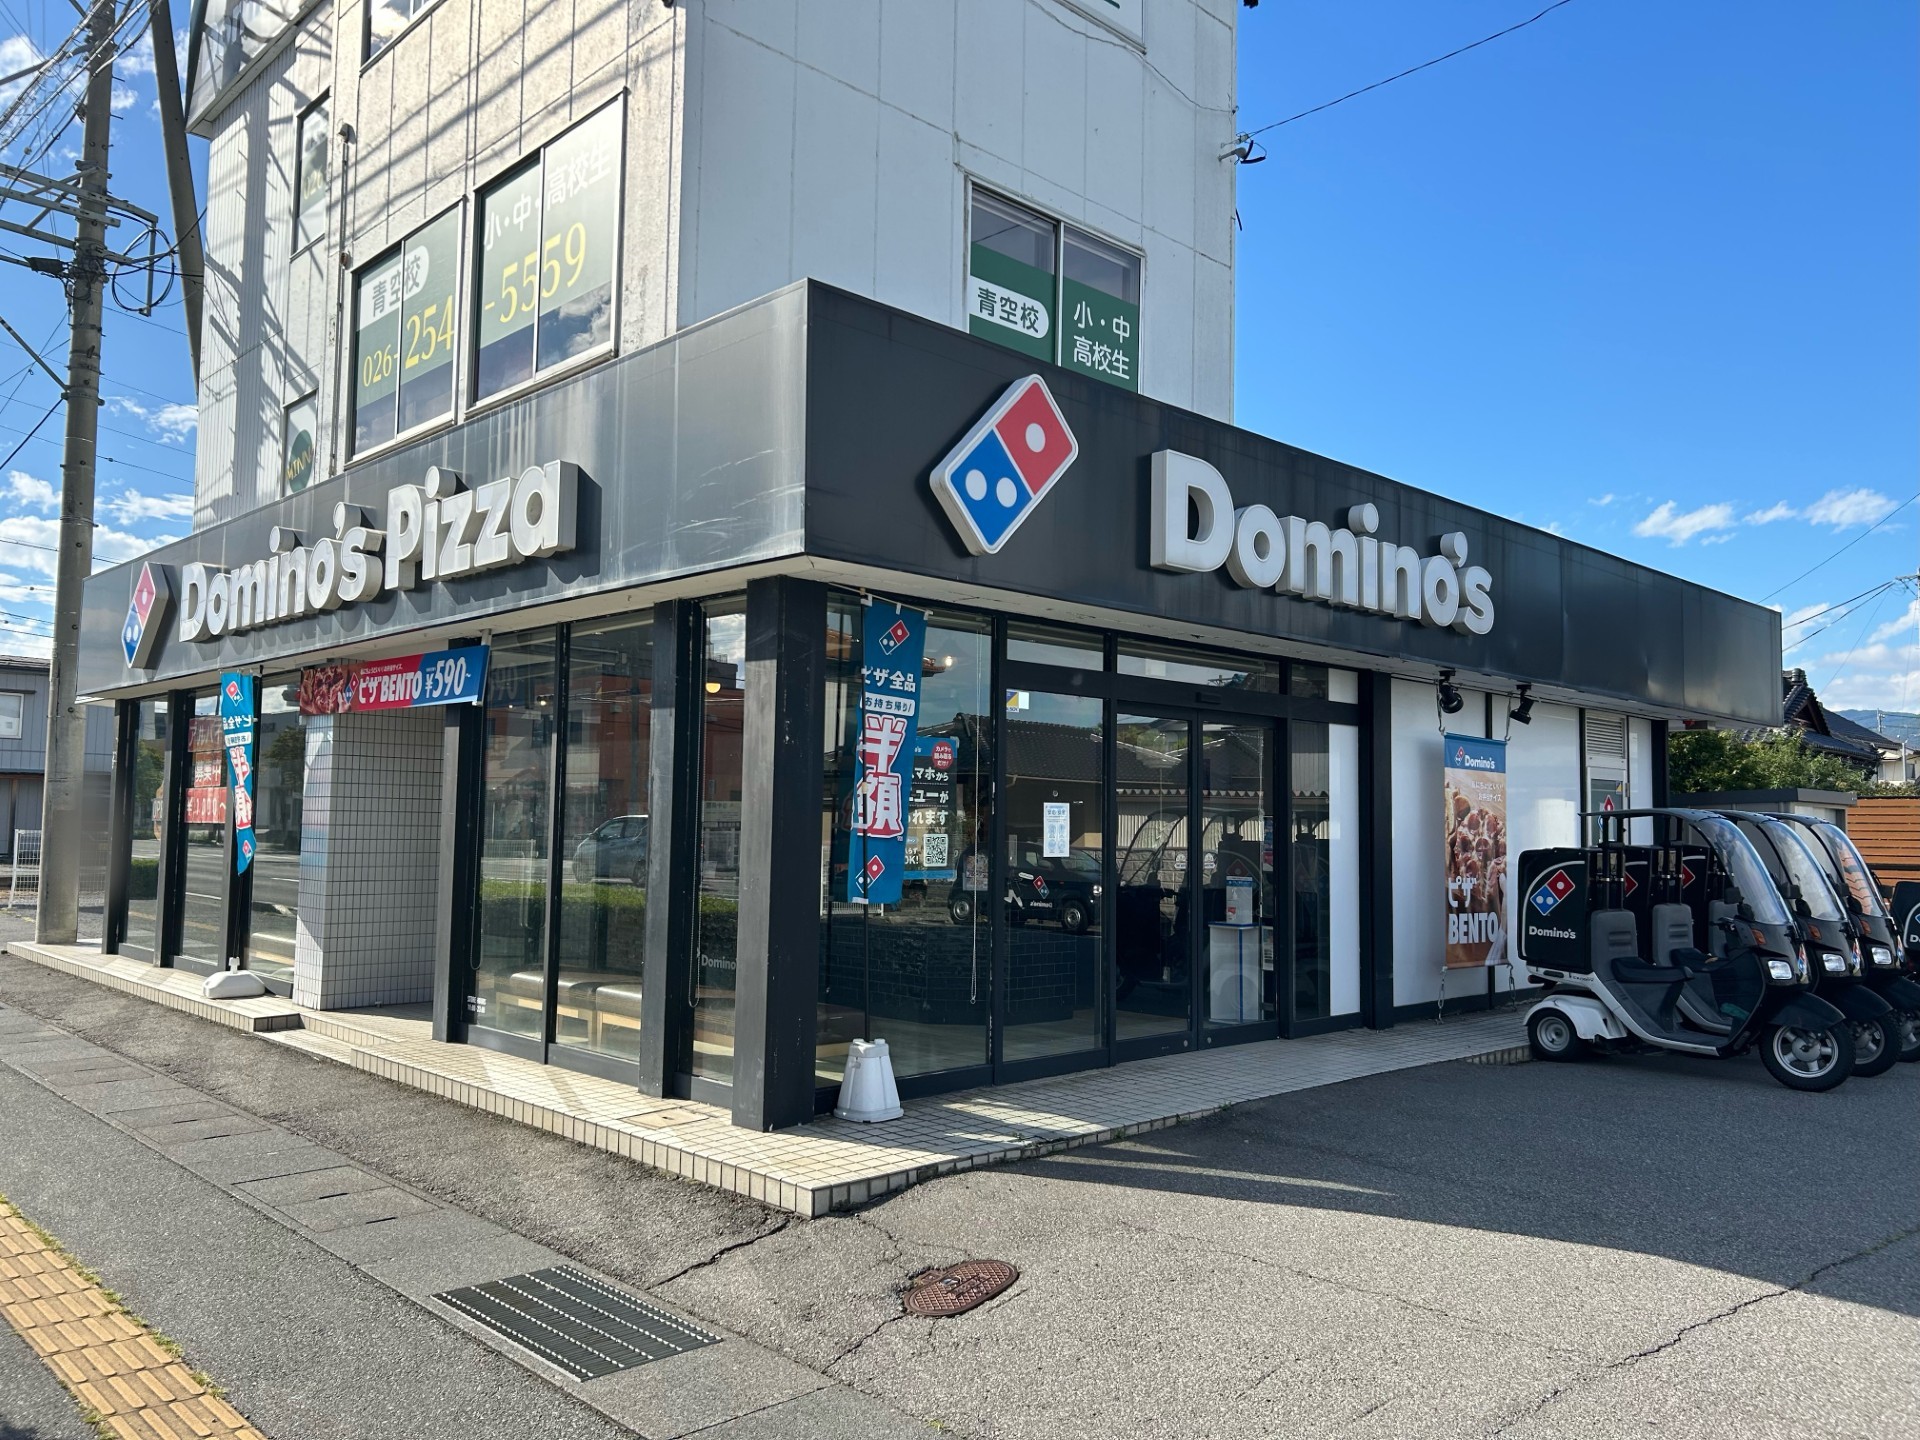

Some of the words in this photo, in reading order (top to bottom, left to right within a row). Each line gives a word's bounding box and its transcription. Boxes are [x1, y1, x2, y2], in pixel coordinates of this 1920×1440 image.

[977, 287, 1040, 334] 青空校
[1072, 335, 1131, 380] 高校生
[179, 501, 386, 643] Domino's
[385, 459, 577, 591] Pizza
[1150, 448, 1495, 635] Domino's
[1465, 753, 1496, 770] Domino's
[1448, 875, 1478, 908] ピザ
[1448, 911, 1499, 945] BENTO
[1528, 925, 1577, 940] Domino's
